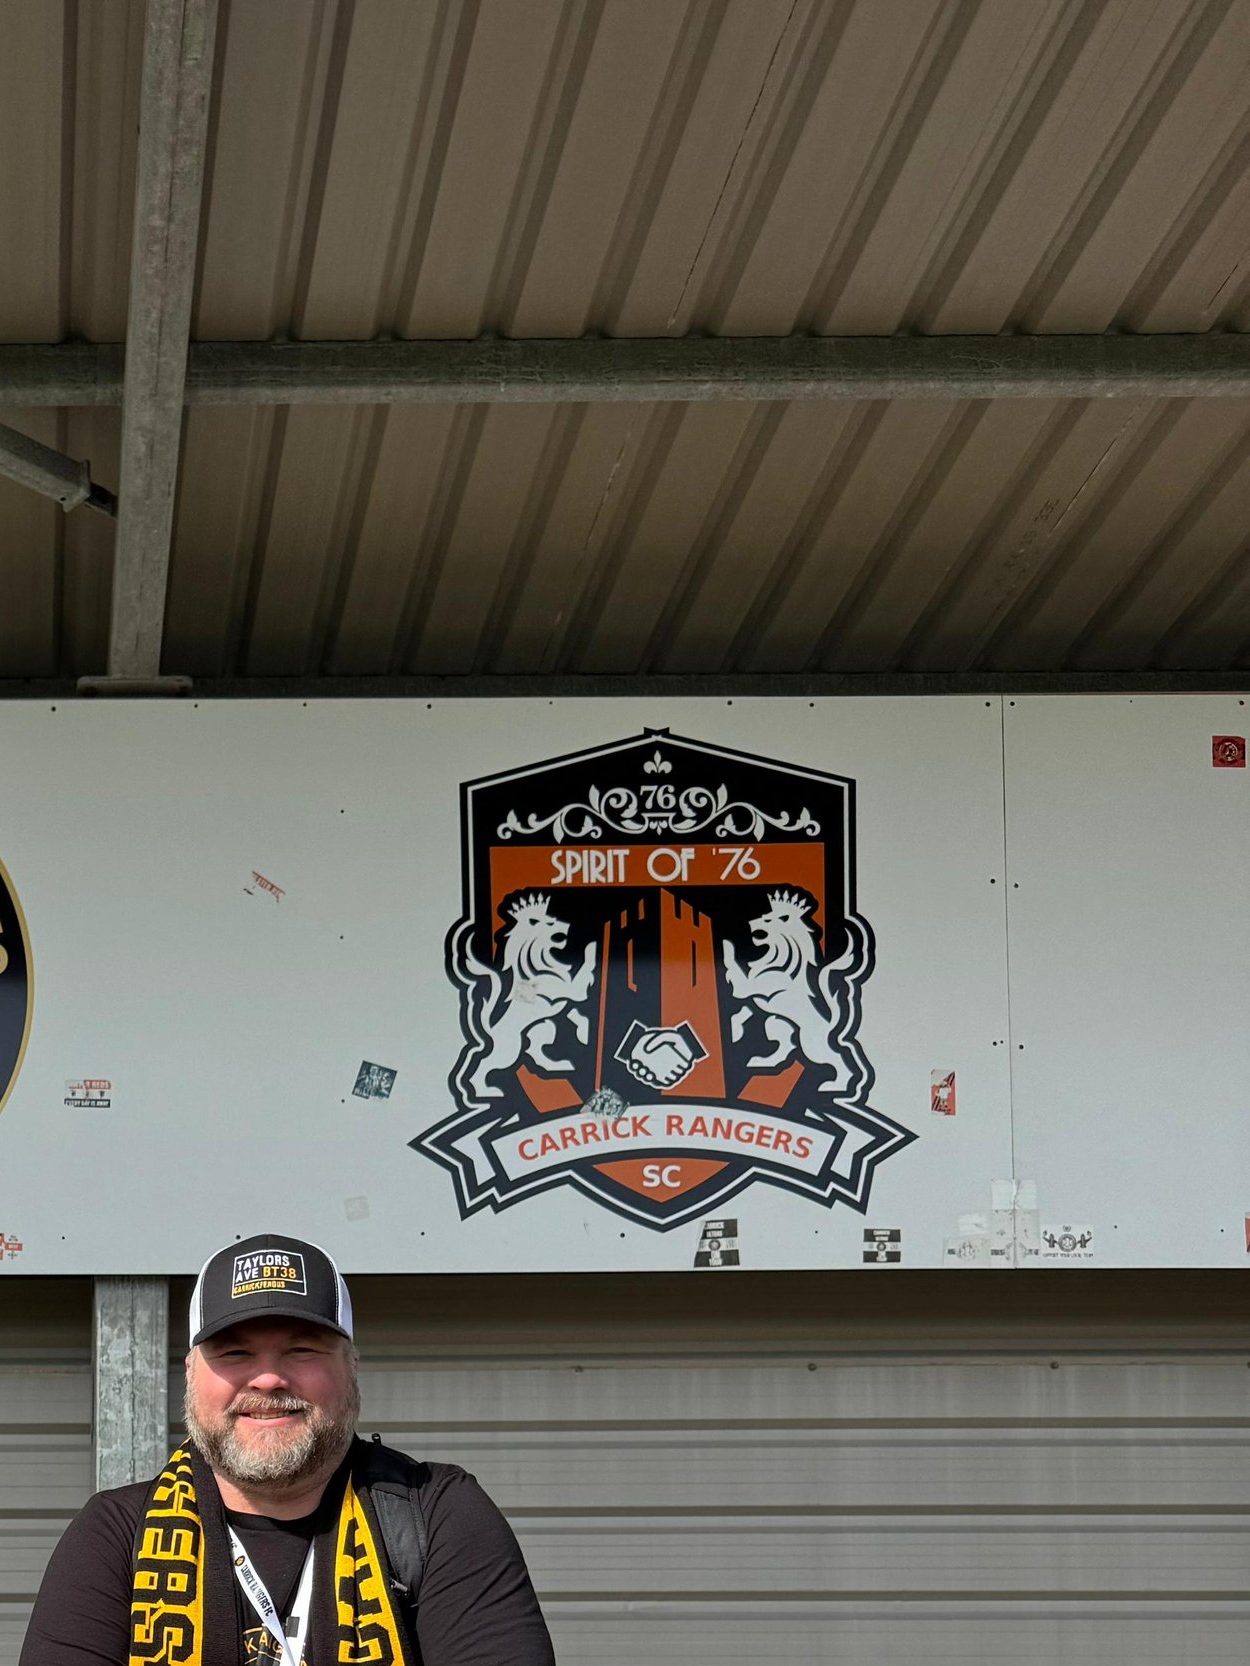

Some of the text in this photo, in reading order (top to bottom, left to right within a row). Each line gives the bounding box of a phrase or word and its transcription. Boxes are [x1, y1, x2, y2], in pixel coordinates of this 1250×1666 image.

[639, 784, 675, 809] 76
[551, 847, 760, 884] SPIRIT OF '76
[517, 1115, 814, 1161] CARRICK RANGERS
[642, 1165, 681, 1188] SC
[235, 1266, 296, 1283] AVE BT38
[237, 1255, 290, 1271] TAYLORS
